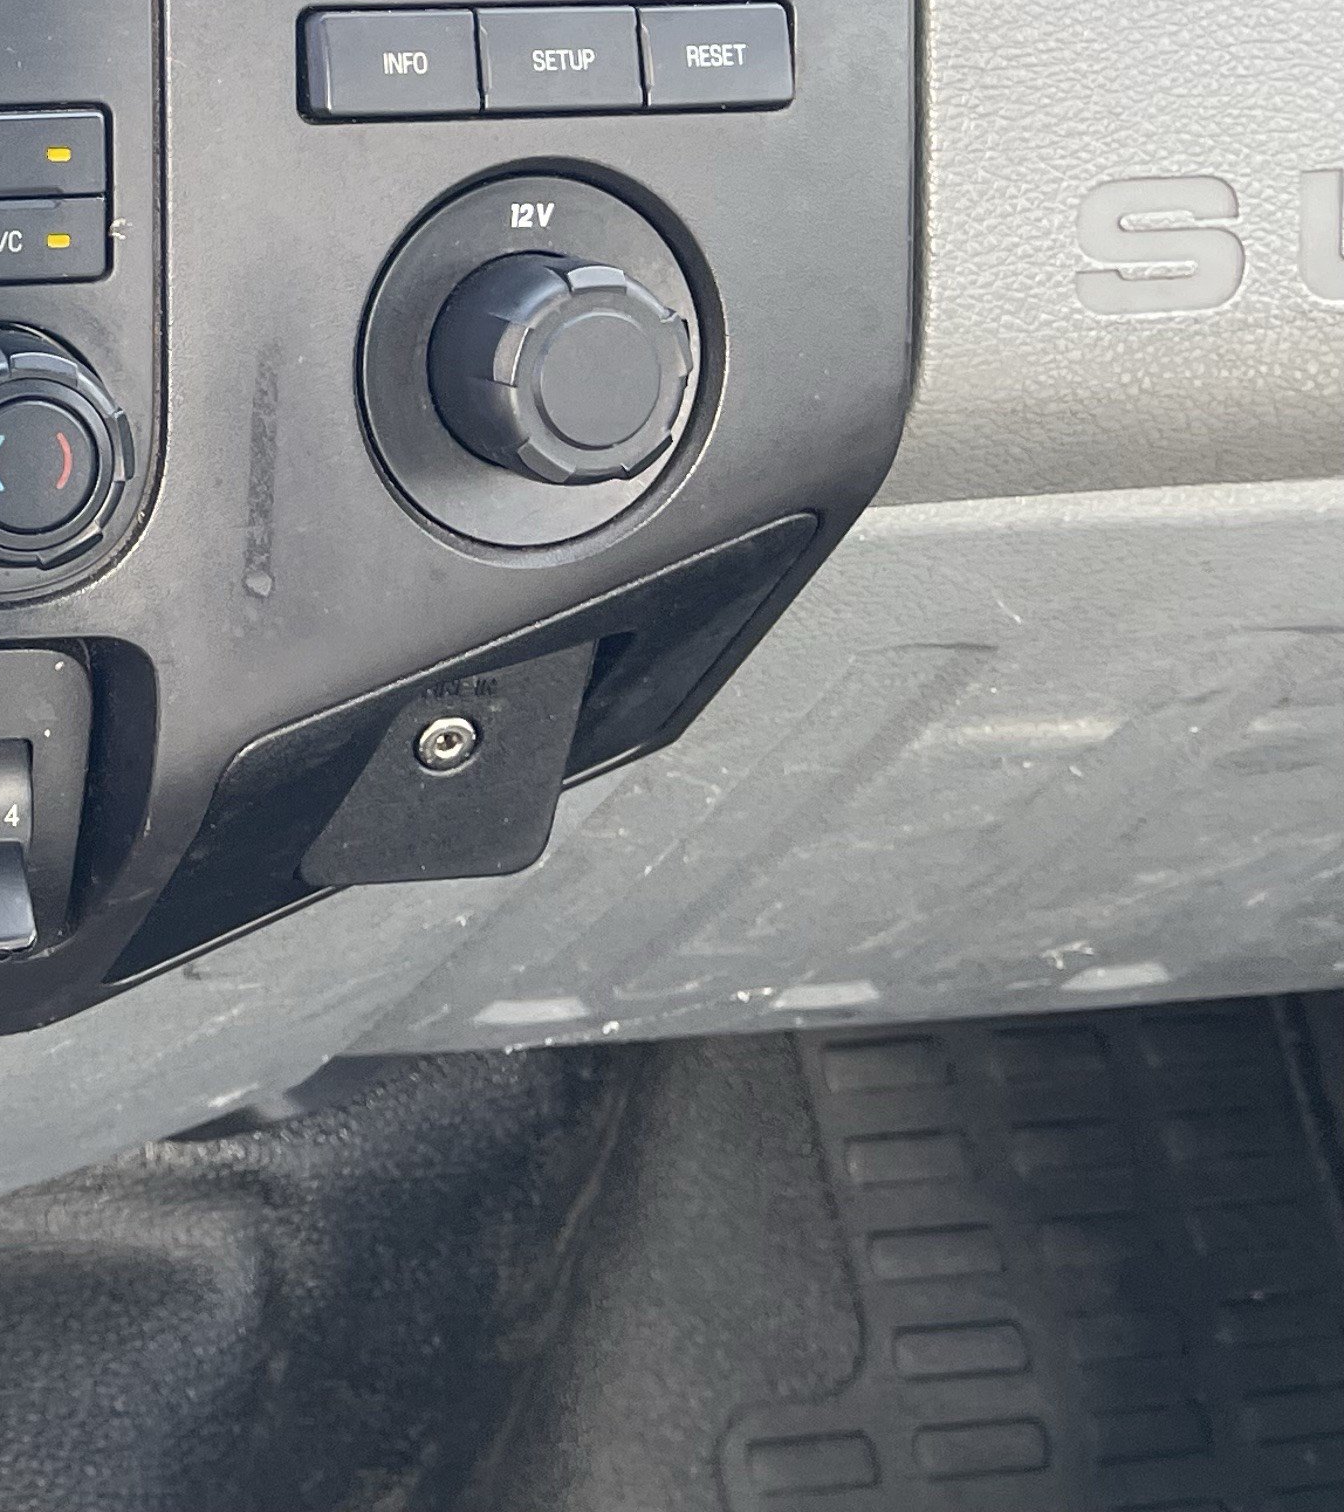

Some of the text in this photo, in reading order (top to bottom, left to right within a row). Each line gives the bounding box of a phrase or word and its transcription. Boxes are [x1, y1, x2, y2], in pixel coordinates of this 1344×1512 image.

[382, 51, 428, 75] INFO
[532, 48, 596, 73] SETUP
[685, 44, 747, 67] RESET
[510, 202, 555, 229] 12V
[3, 804, 20, 828] 4
